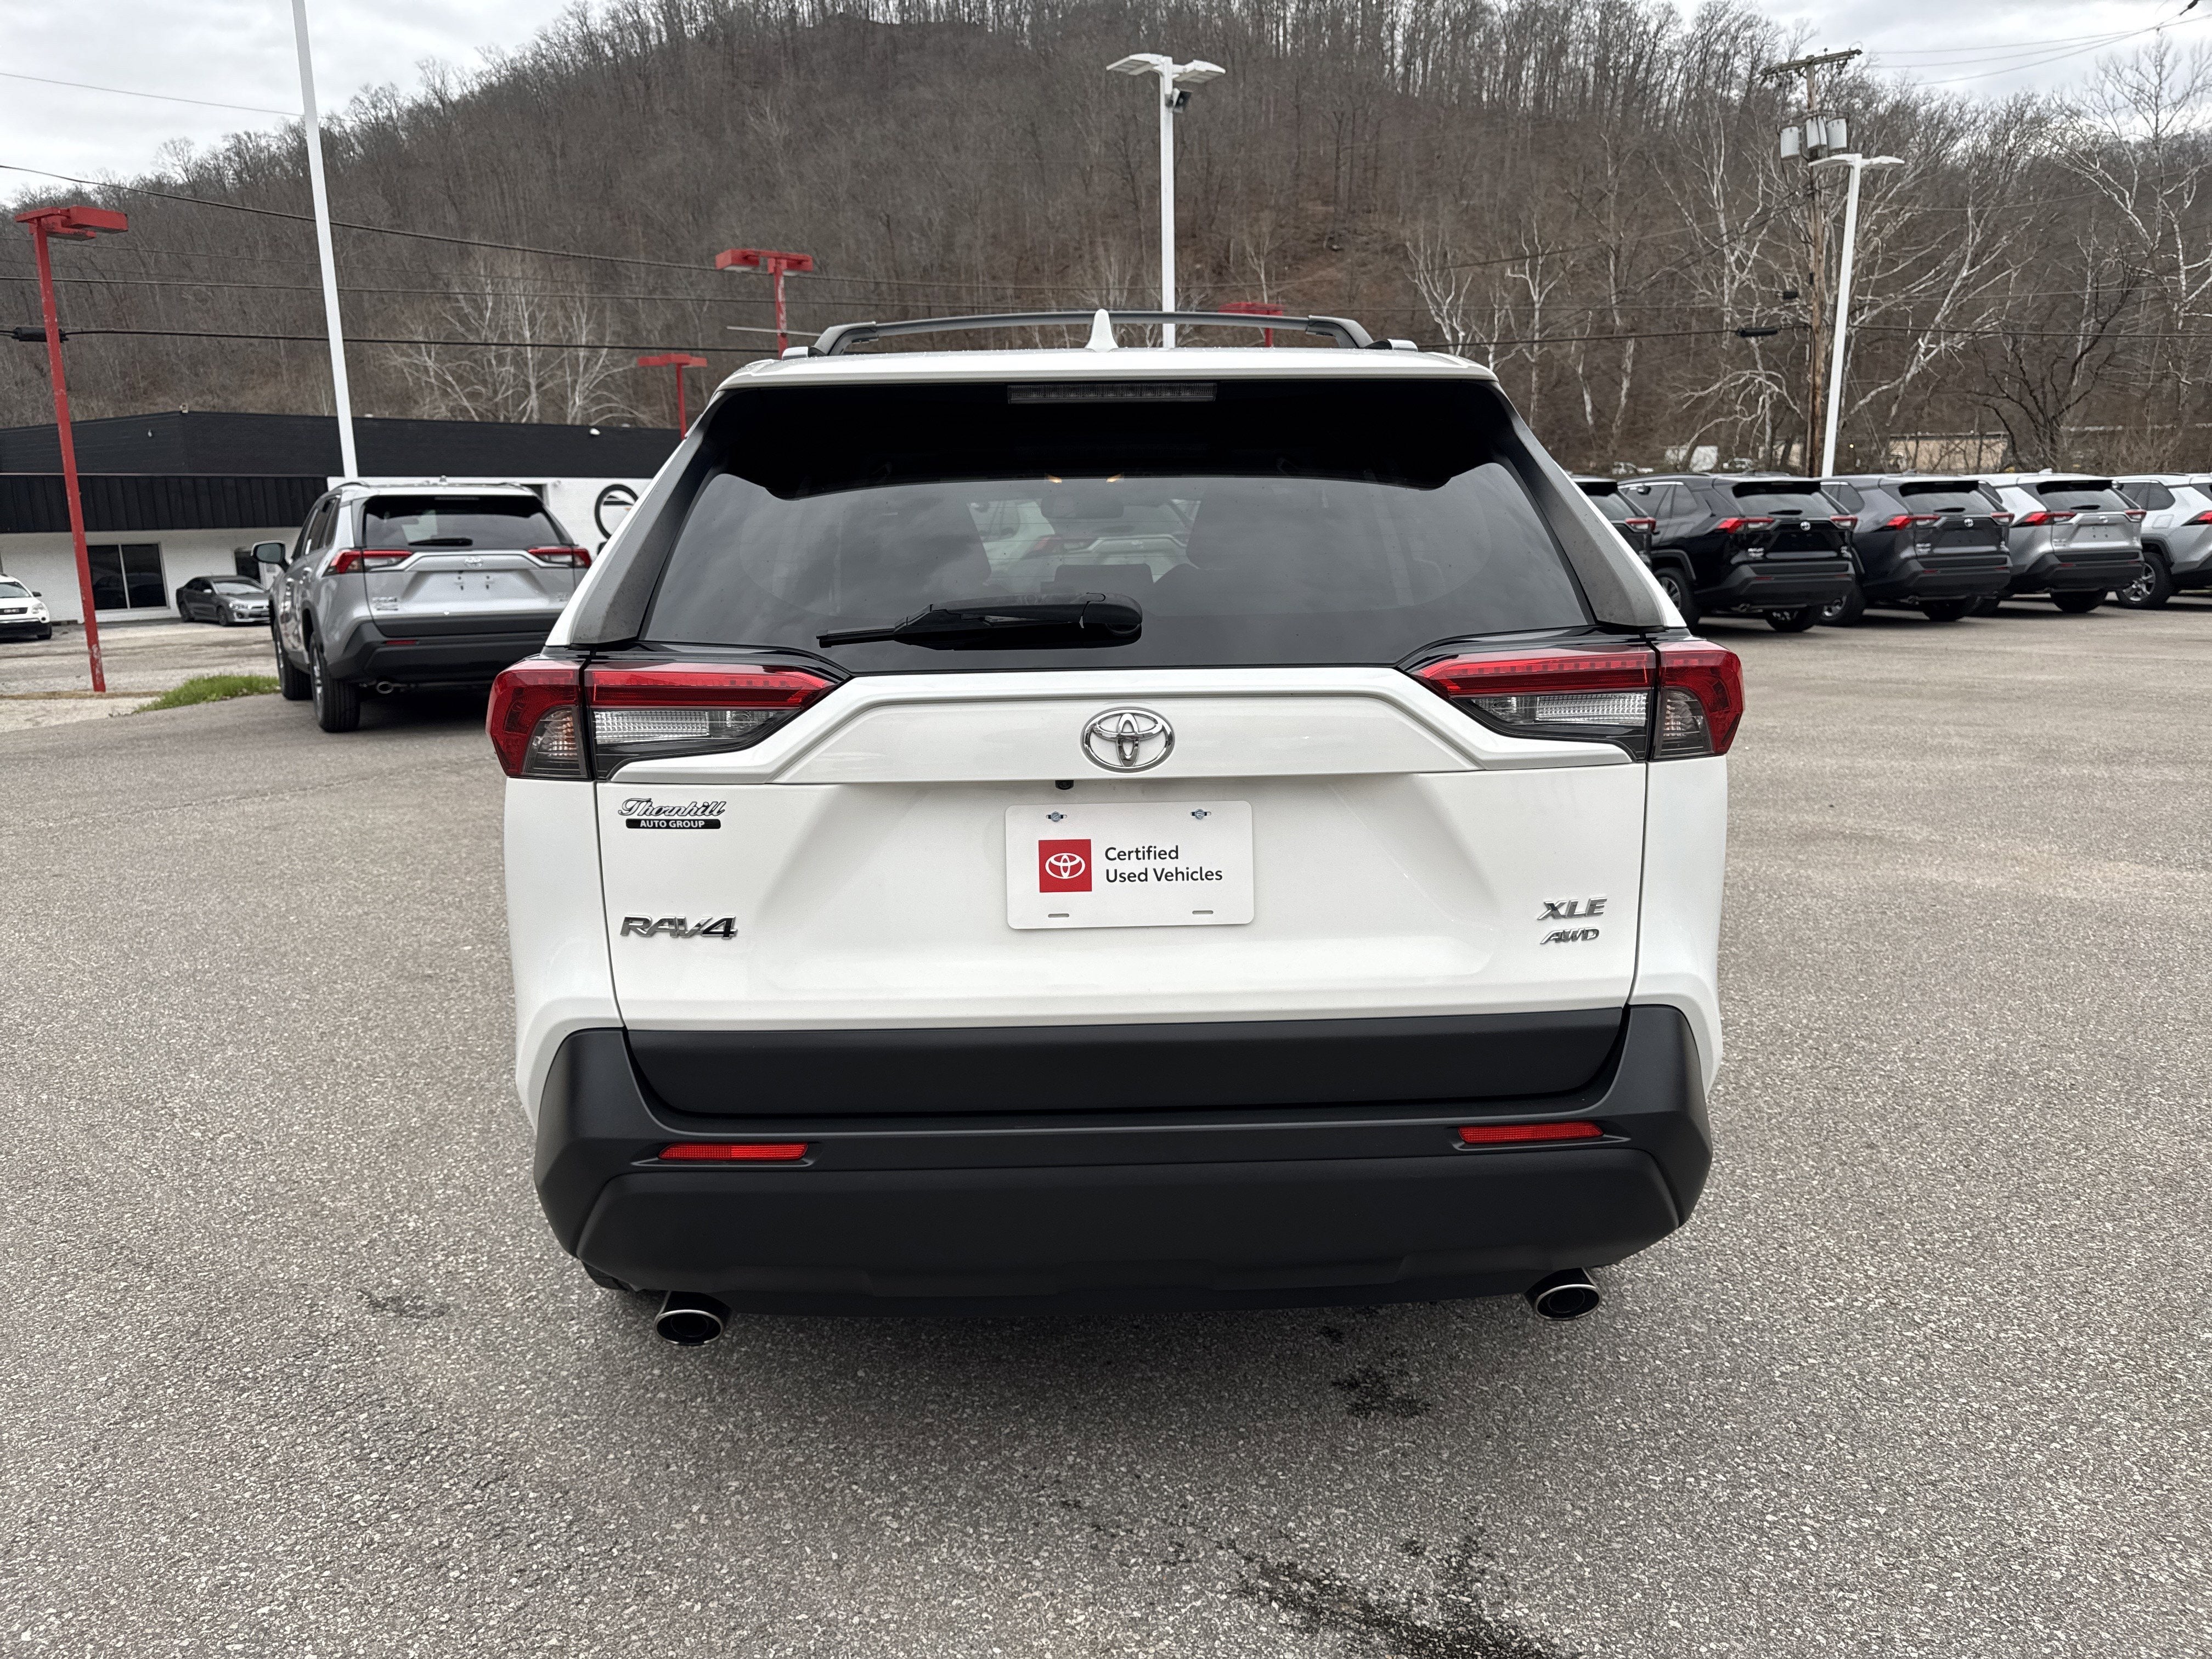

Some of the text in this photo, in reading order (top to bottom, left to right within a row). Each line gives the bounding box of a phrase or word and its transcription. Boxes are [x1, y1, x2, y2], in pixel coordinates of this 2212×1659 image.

[618, 798, 726, 816] Thornhill
[640, 820, 705, 828] AUTO GROUP
[1104, 845, 1179, 861] Certified
[1105, 867, 1223, 883] Used Vehicles
[1537, 896, 1607, 920] XLE
[620, 915, 738, 939] RAV4
[1540, 927, 1600, 944] AWD
